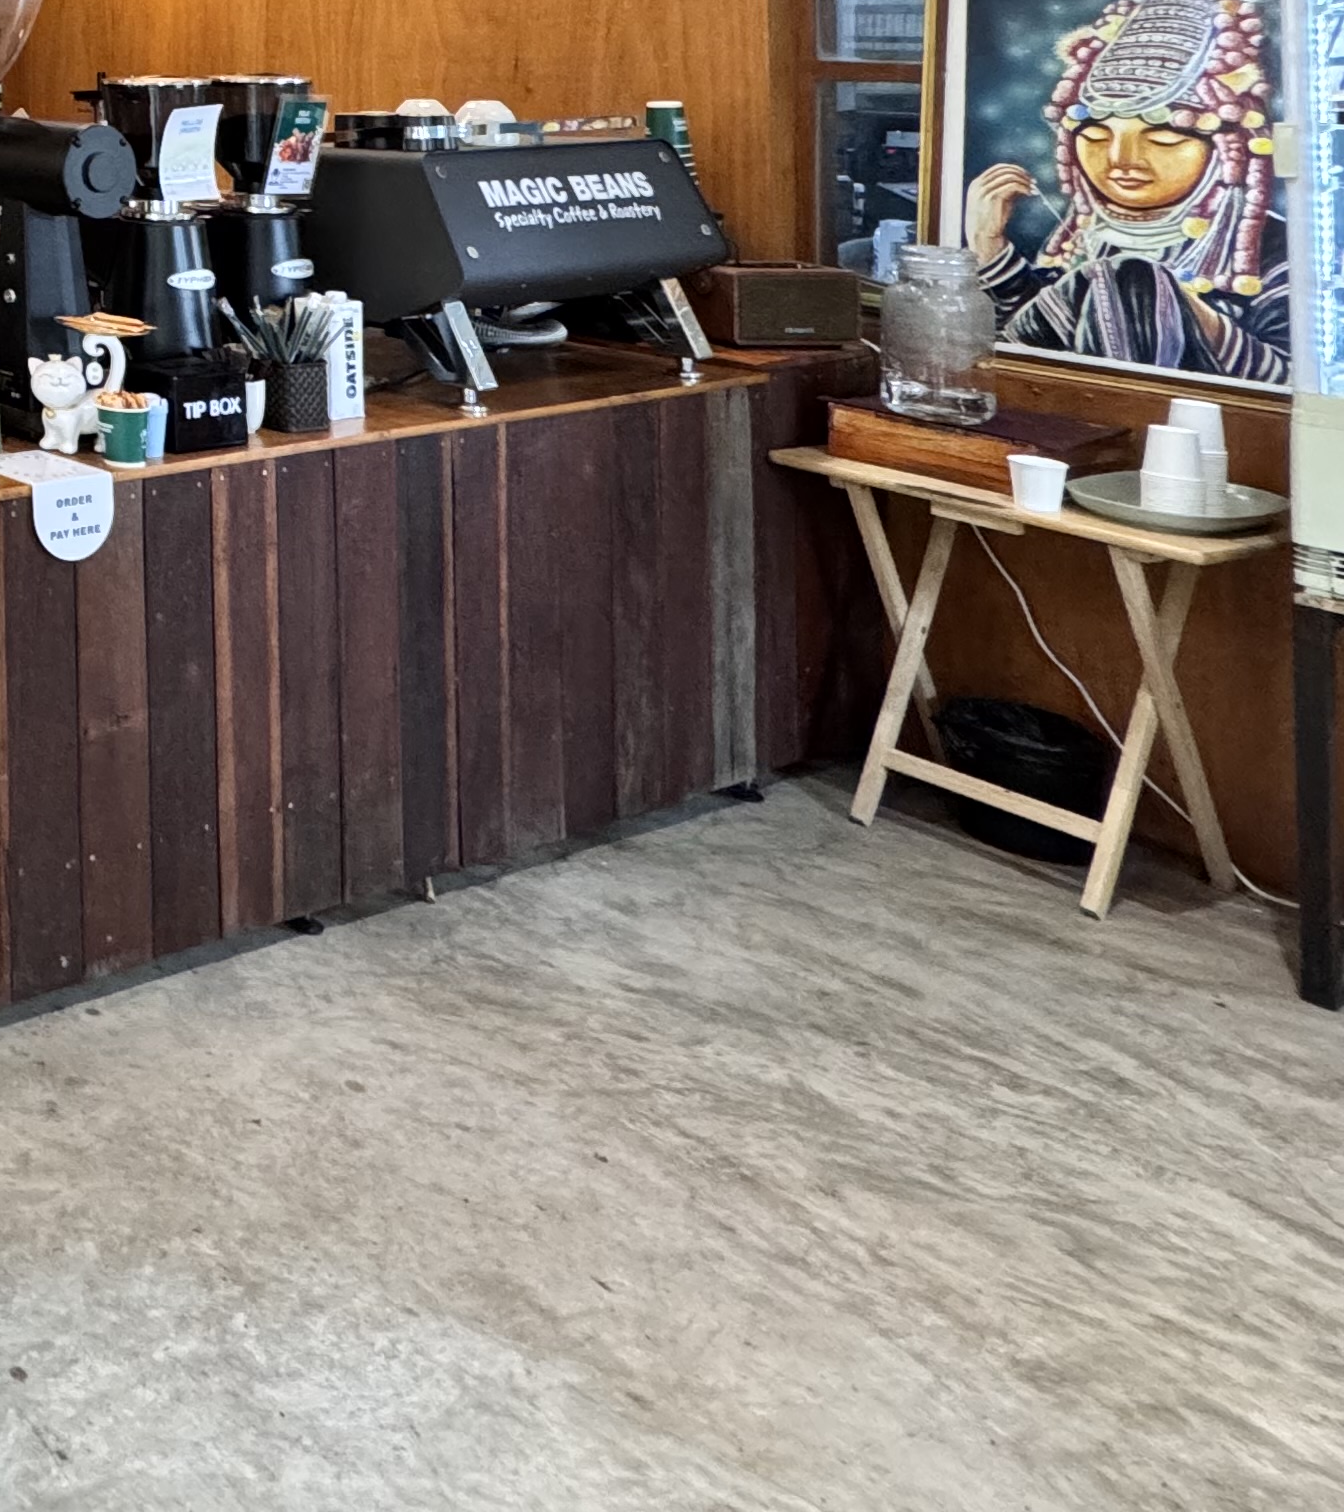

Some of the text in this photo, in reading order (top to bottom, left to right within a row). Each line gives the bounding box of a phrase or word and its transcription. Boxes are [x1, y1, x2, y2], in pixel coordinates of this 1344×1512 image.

[477, 171, 654, 208] MAGIC BEANS
[494, 201, 662, 232] Specialty Coffee & Roastery
[342, 316, 357, 399] OATSIDE
[182, 396, 242, 419] TIP BOX
[55, 494, 93, 508] ORDER
[71, 512, 79, 521] &
[50, 524, 101, 541] PAY HERE
